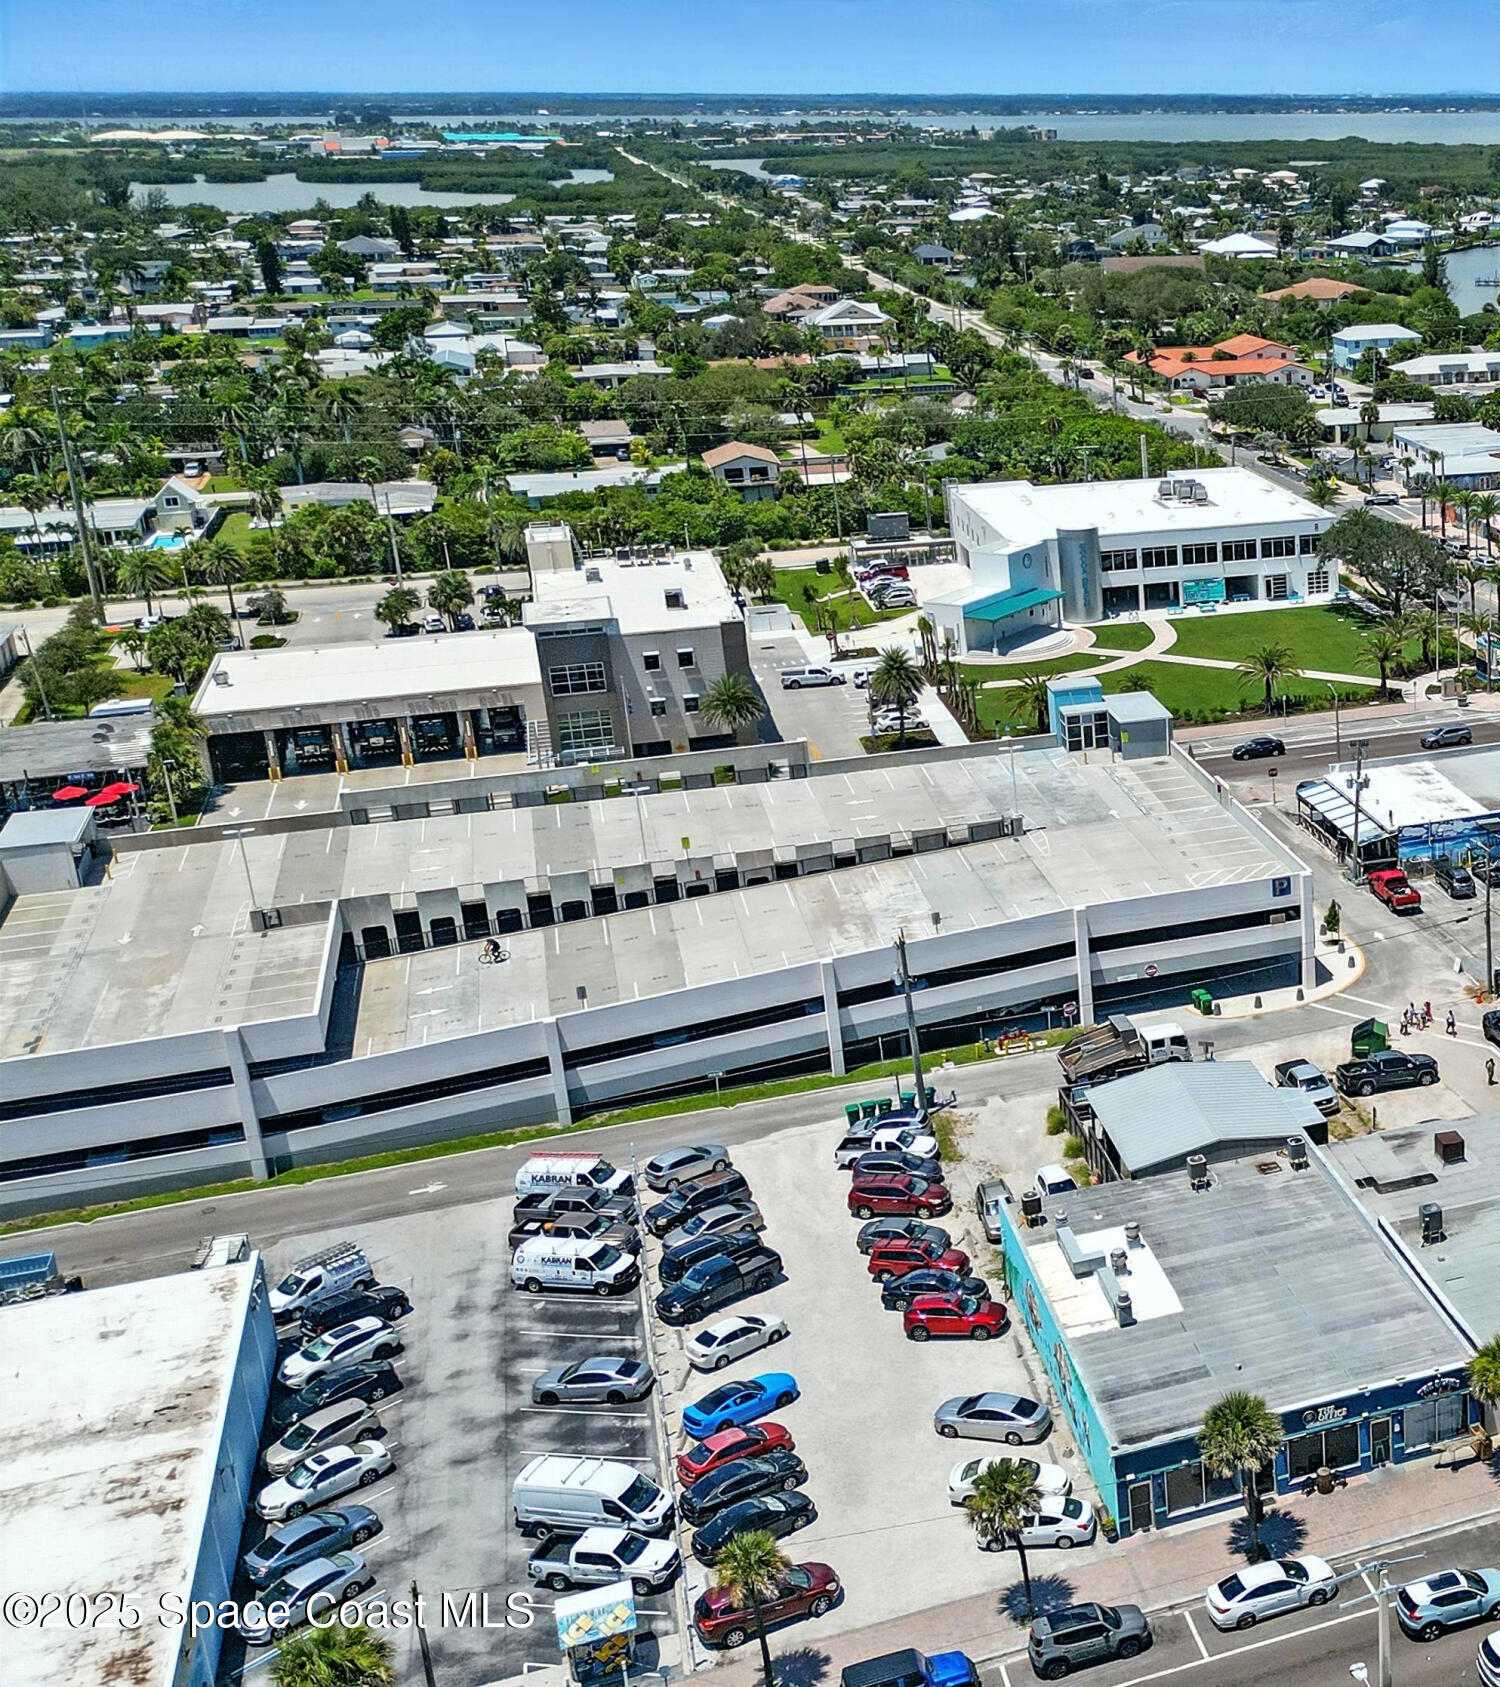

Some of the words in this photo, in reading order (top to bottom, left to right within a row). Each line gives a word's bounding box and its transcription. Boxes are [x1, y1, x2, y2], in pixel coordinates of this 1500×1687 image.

[1275, 879, 1287, 895] P
[531, 1174, 572, 1184] KABRAN
[541, 1256, 572, 1265] KABRAN
